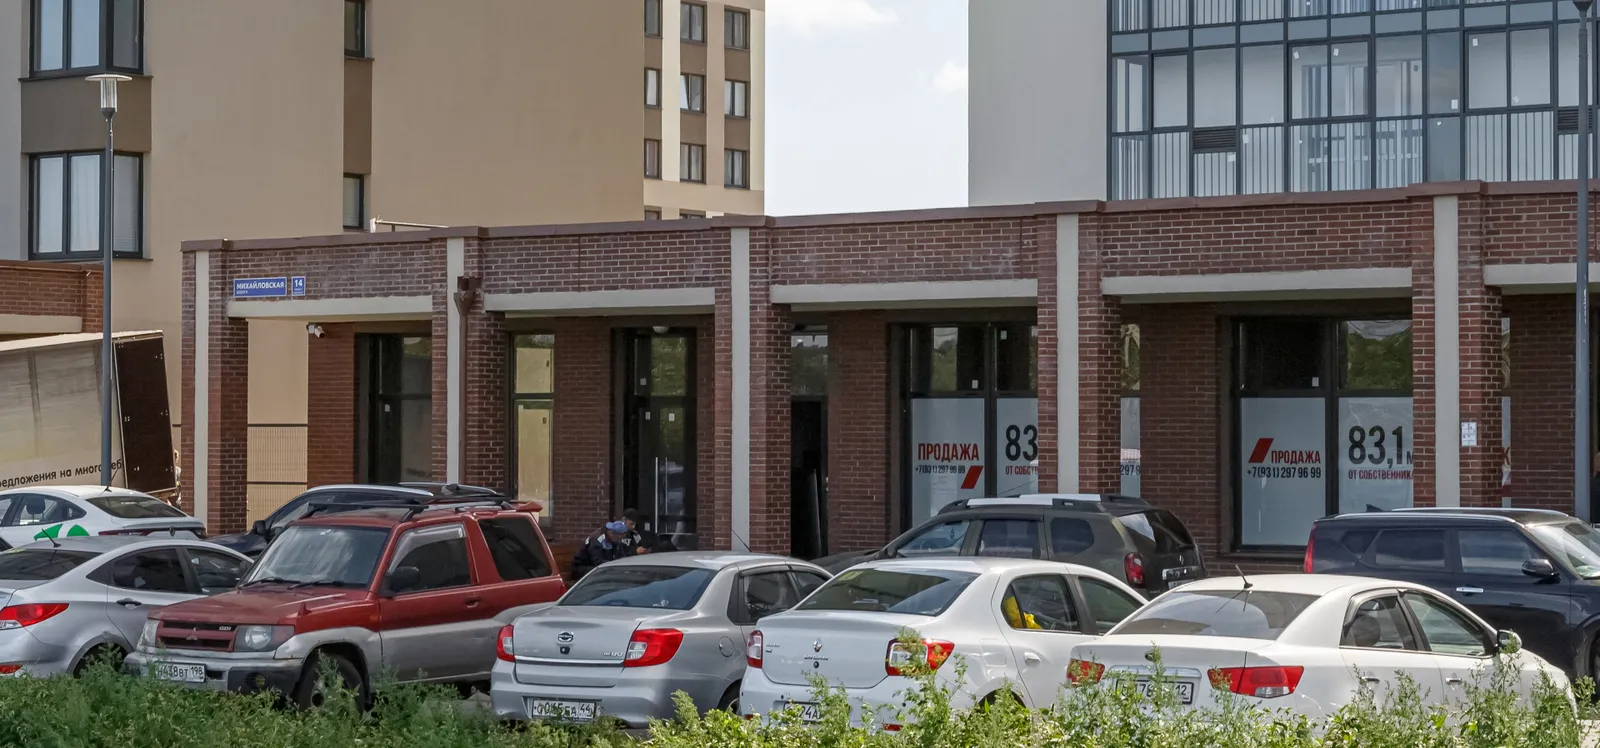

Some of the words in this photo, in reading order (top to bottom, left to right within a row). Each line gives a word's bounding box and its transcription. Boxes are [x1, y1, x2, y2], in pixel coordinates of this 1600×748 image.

[236, 281, 285, 289] МИХАЙЛОВСКАЯ
[294, 279, 303, 287] 14
[1348, 425, 1403, 469] 83,1
[918, 443, 980, 463] ПРОДАЖА
[1271, 450, 1321, 465] ПРОДАЖА
[60, 469, 72, 478] на
[938, 465, 949, 474] 297
[958, 465, 965, 474] 99
[1005, 466, 1014, 475] ОТ
[1281, 467, 1296, 478] 297
[1297, 467, 1309, 478] 96
[1310, 467, 1322, 478] 99
[1348, 470, 1358, 480] ОТ
[1175, 684, 1187, 696] 12
